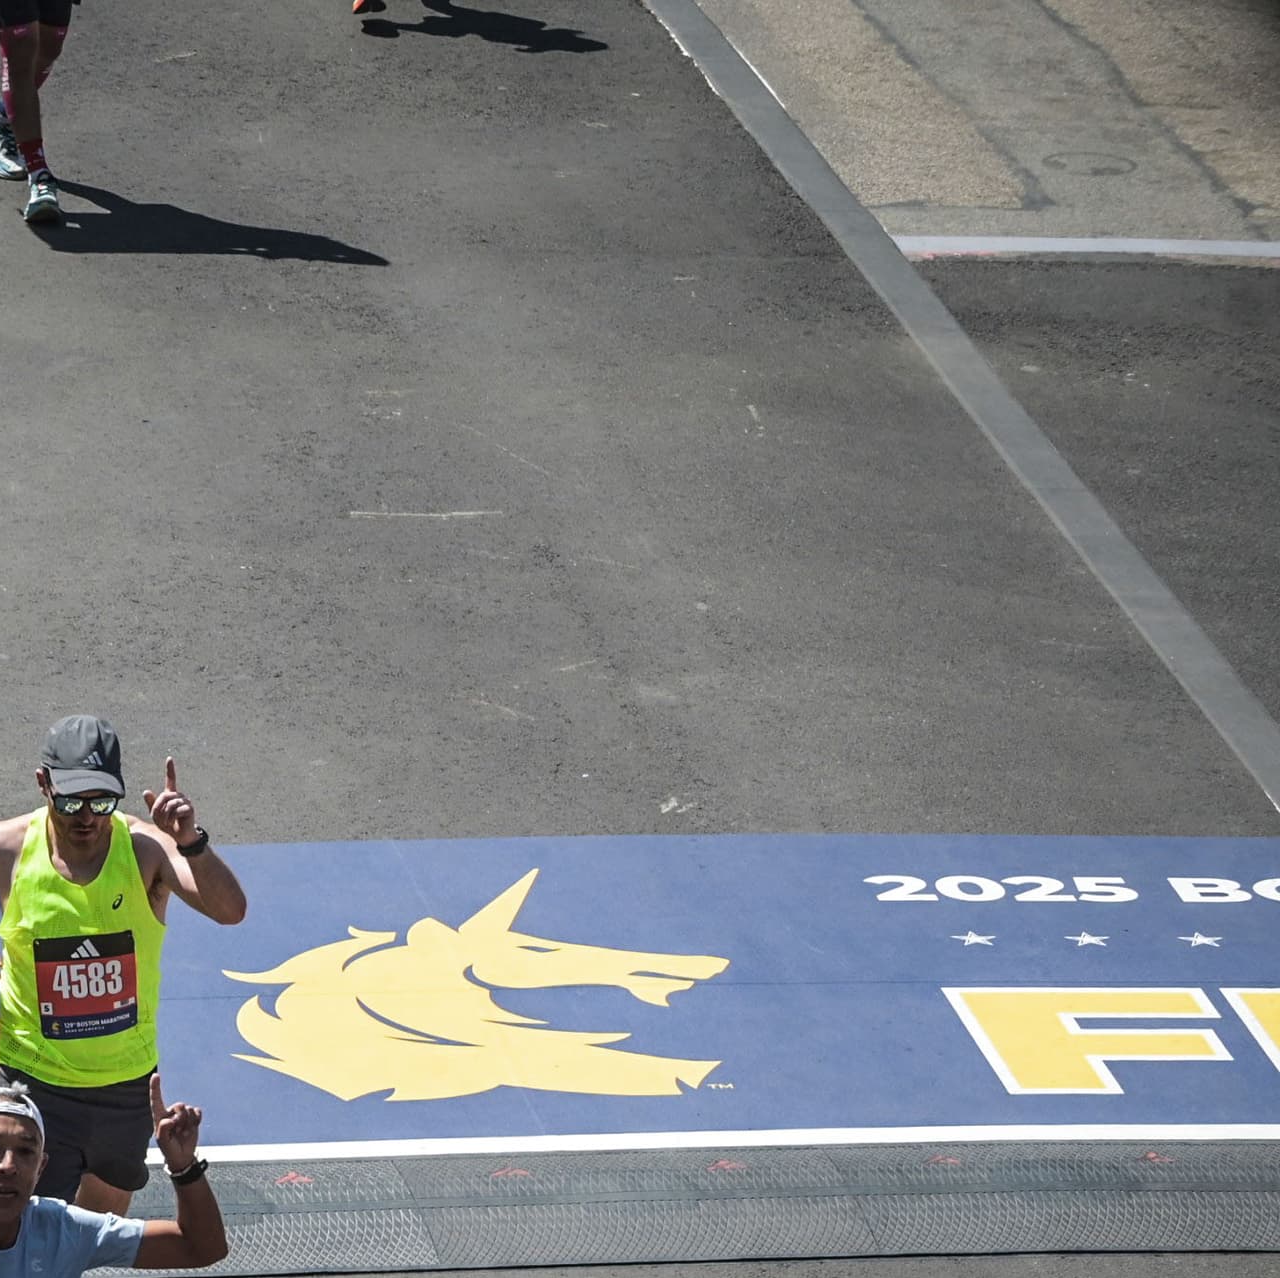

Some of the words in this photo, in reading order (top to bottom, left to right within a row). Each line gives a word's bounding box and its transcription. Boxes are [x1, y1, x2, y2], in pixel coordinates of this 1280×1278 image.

[863, 874, 1139, 903] 2025
[53, 960, 123, 999] 4583
[101, 1013, 130, 1025] MARATHON
